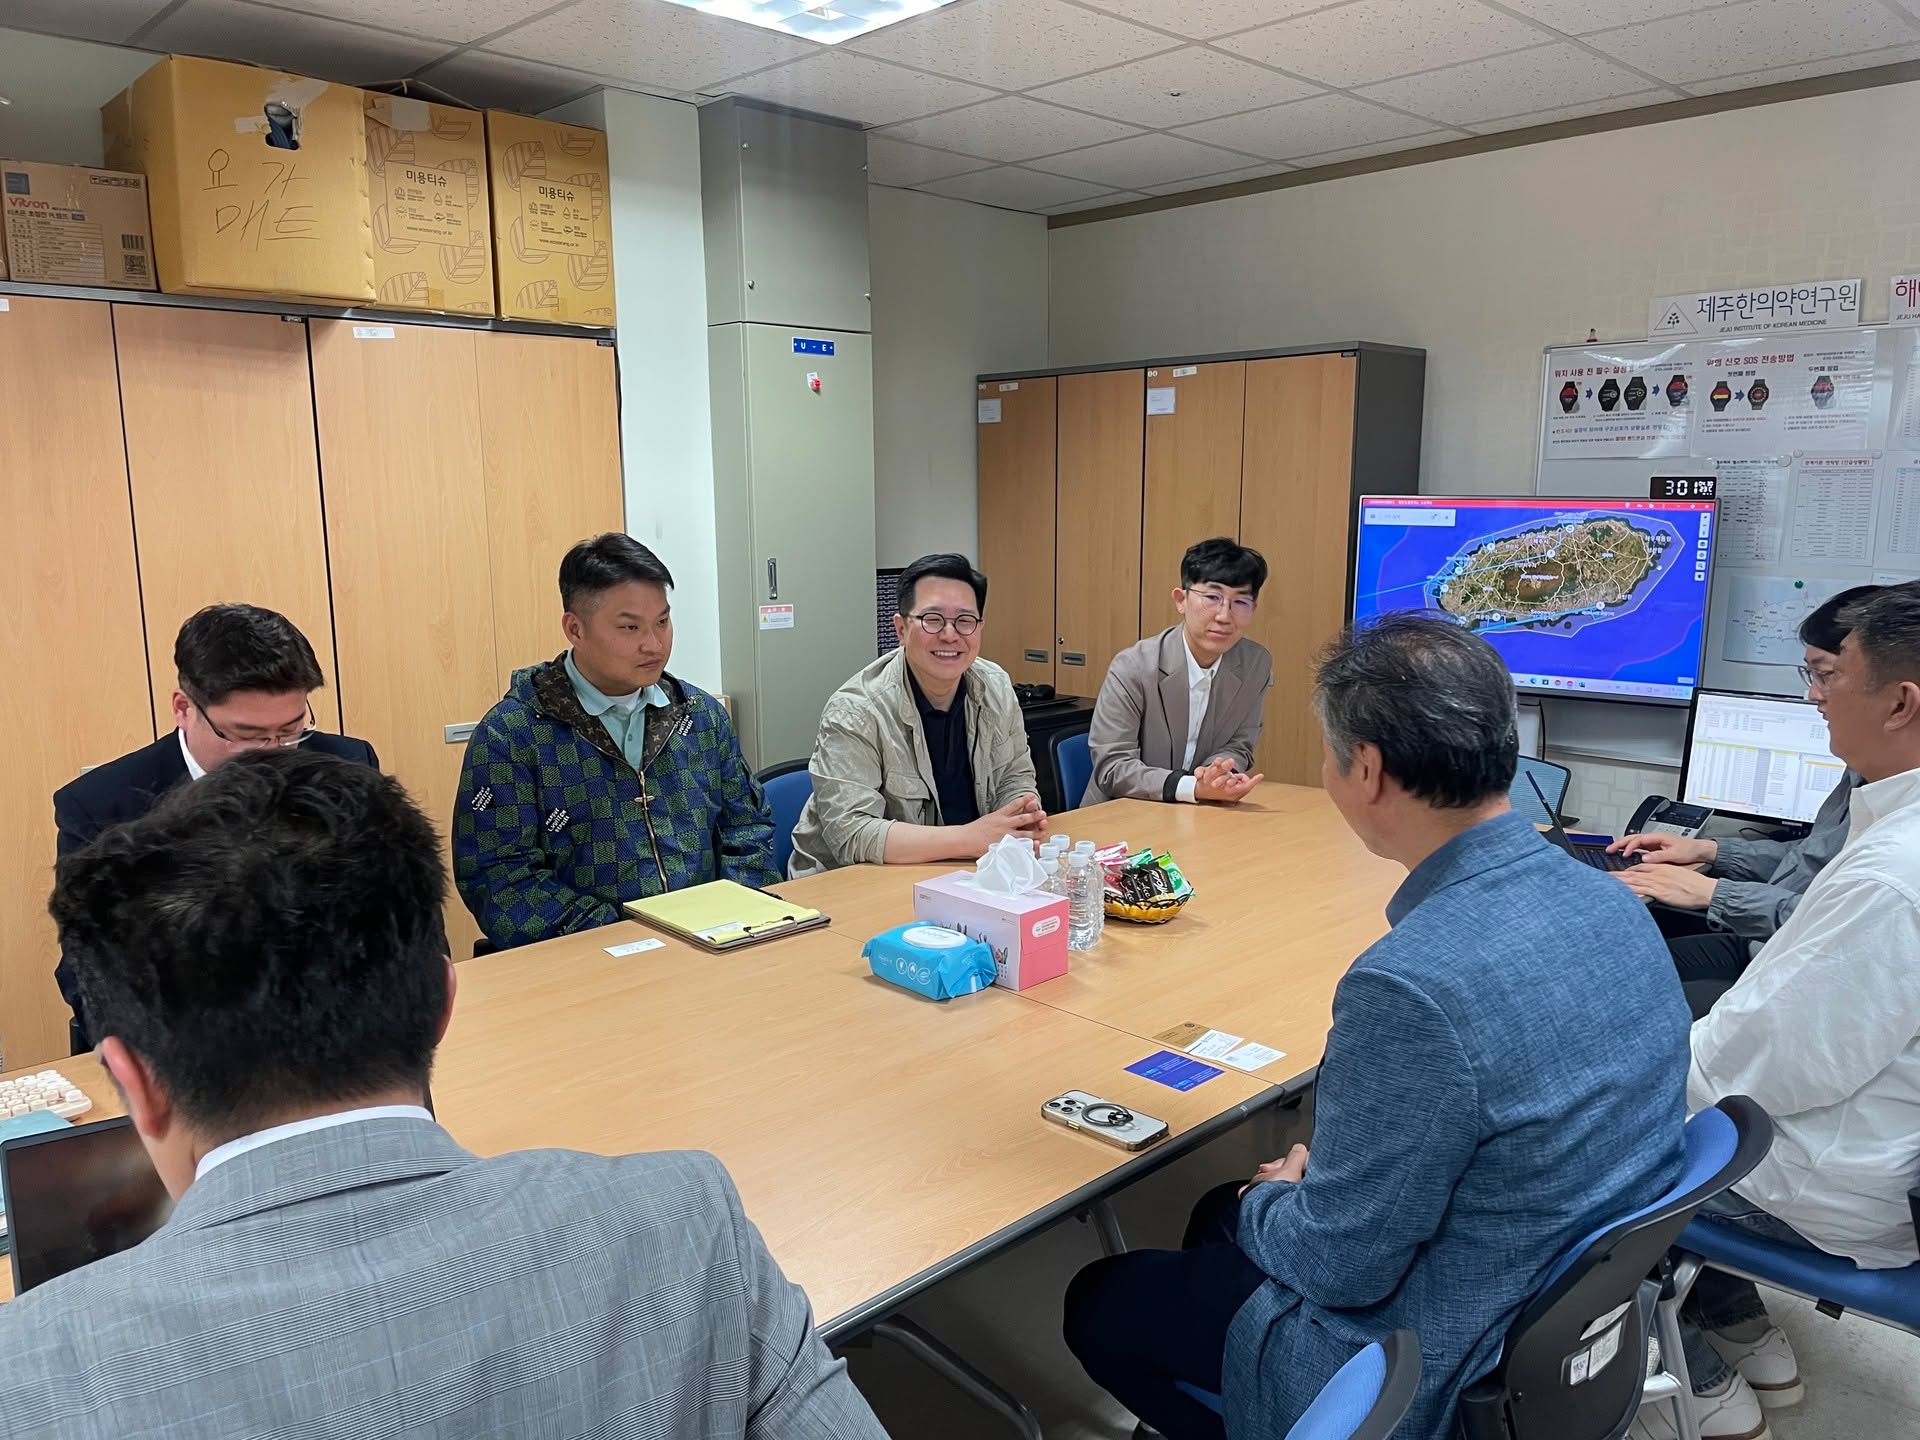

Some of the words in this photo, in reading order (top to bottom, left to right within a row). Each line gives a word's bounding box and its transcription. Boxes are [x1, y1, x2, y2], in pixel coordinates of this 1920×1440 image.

[406, 170, 447, 187] 미용티슈
[538, 186, 575, 202] 미용티슈
[1895, 279, 1920, 307] 해
[1697, 283, 1857, 323] 제주한의약연구원
[1734, 324, 1762, 332] INSTITUTE
[1744, 356, 1758, 364] SOS
